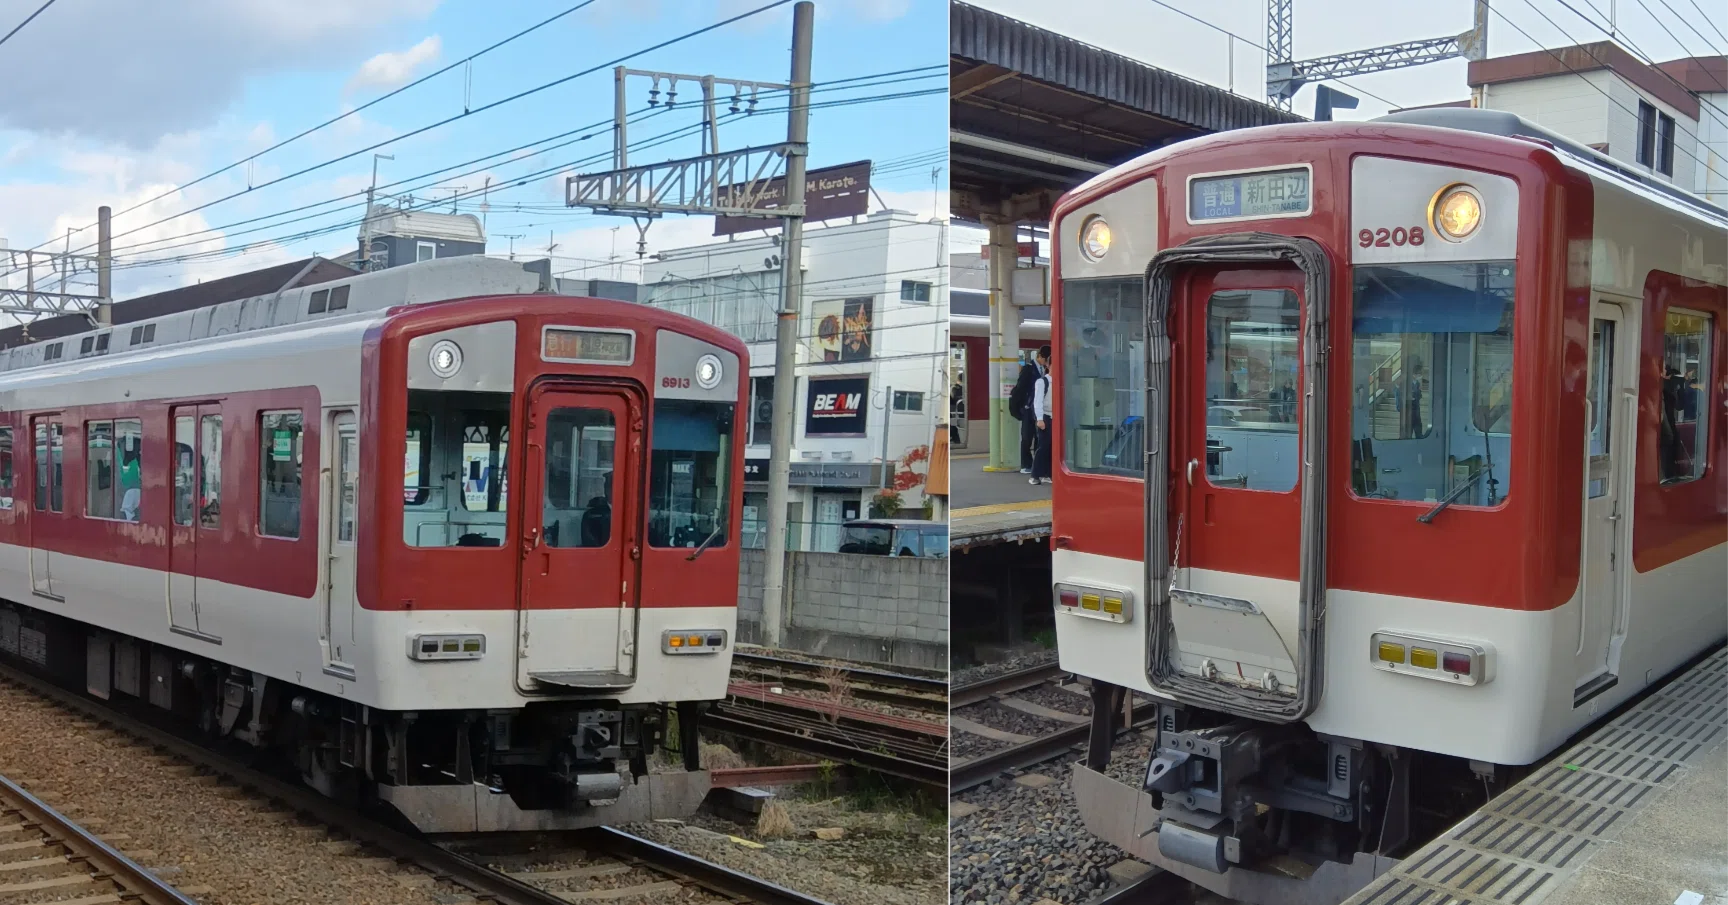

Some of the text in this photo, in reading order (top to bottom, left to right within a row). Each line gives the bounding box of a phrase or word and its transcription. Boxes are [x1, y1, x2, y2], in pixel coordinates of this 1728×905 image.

[1203, 174, 1307, 208] 普通 新田辺
[1204, 201, 1302, 217] LOCAL SHIN-TANABE
[1358, 226, 1425, 249] 9208
[813, 393, 861, 411] BEAM
